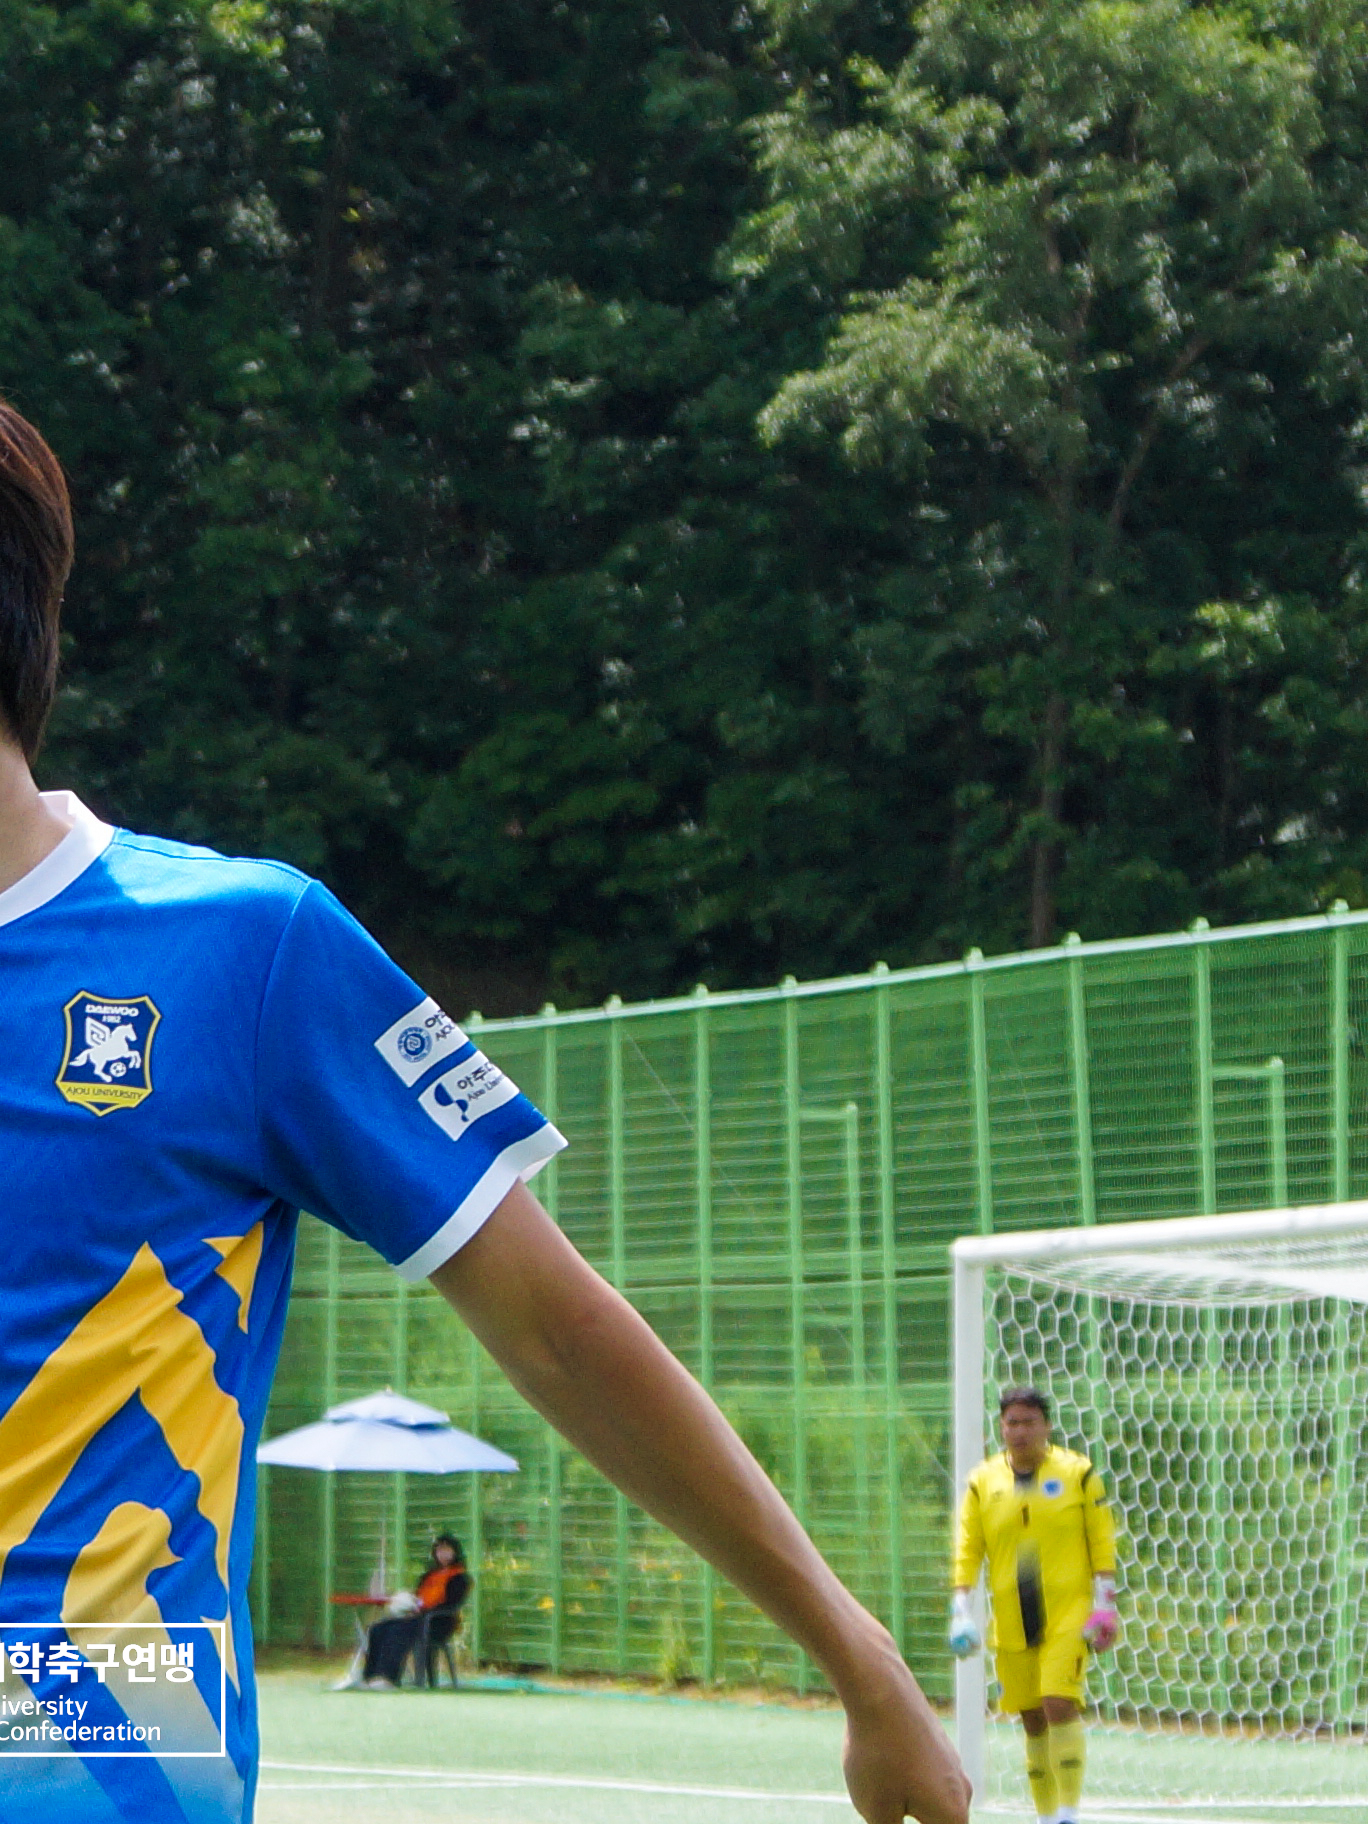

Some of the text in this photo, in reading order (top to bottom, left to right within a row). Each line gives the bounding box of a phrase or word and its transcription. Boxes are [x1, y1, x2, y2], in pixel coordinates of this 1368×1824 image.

[85, 1004, 139, 1017] DAEWOO
[66, 1086, 143, 1099] AJOU UNIVERSITY
